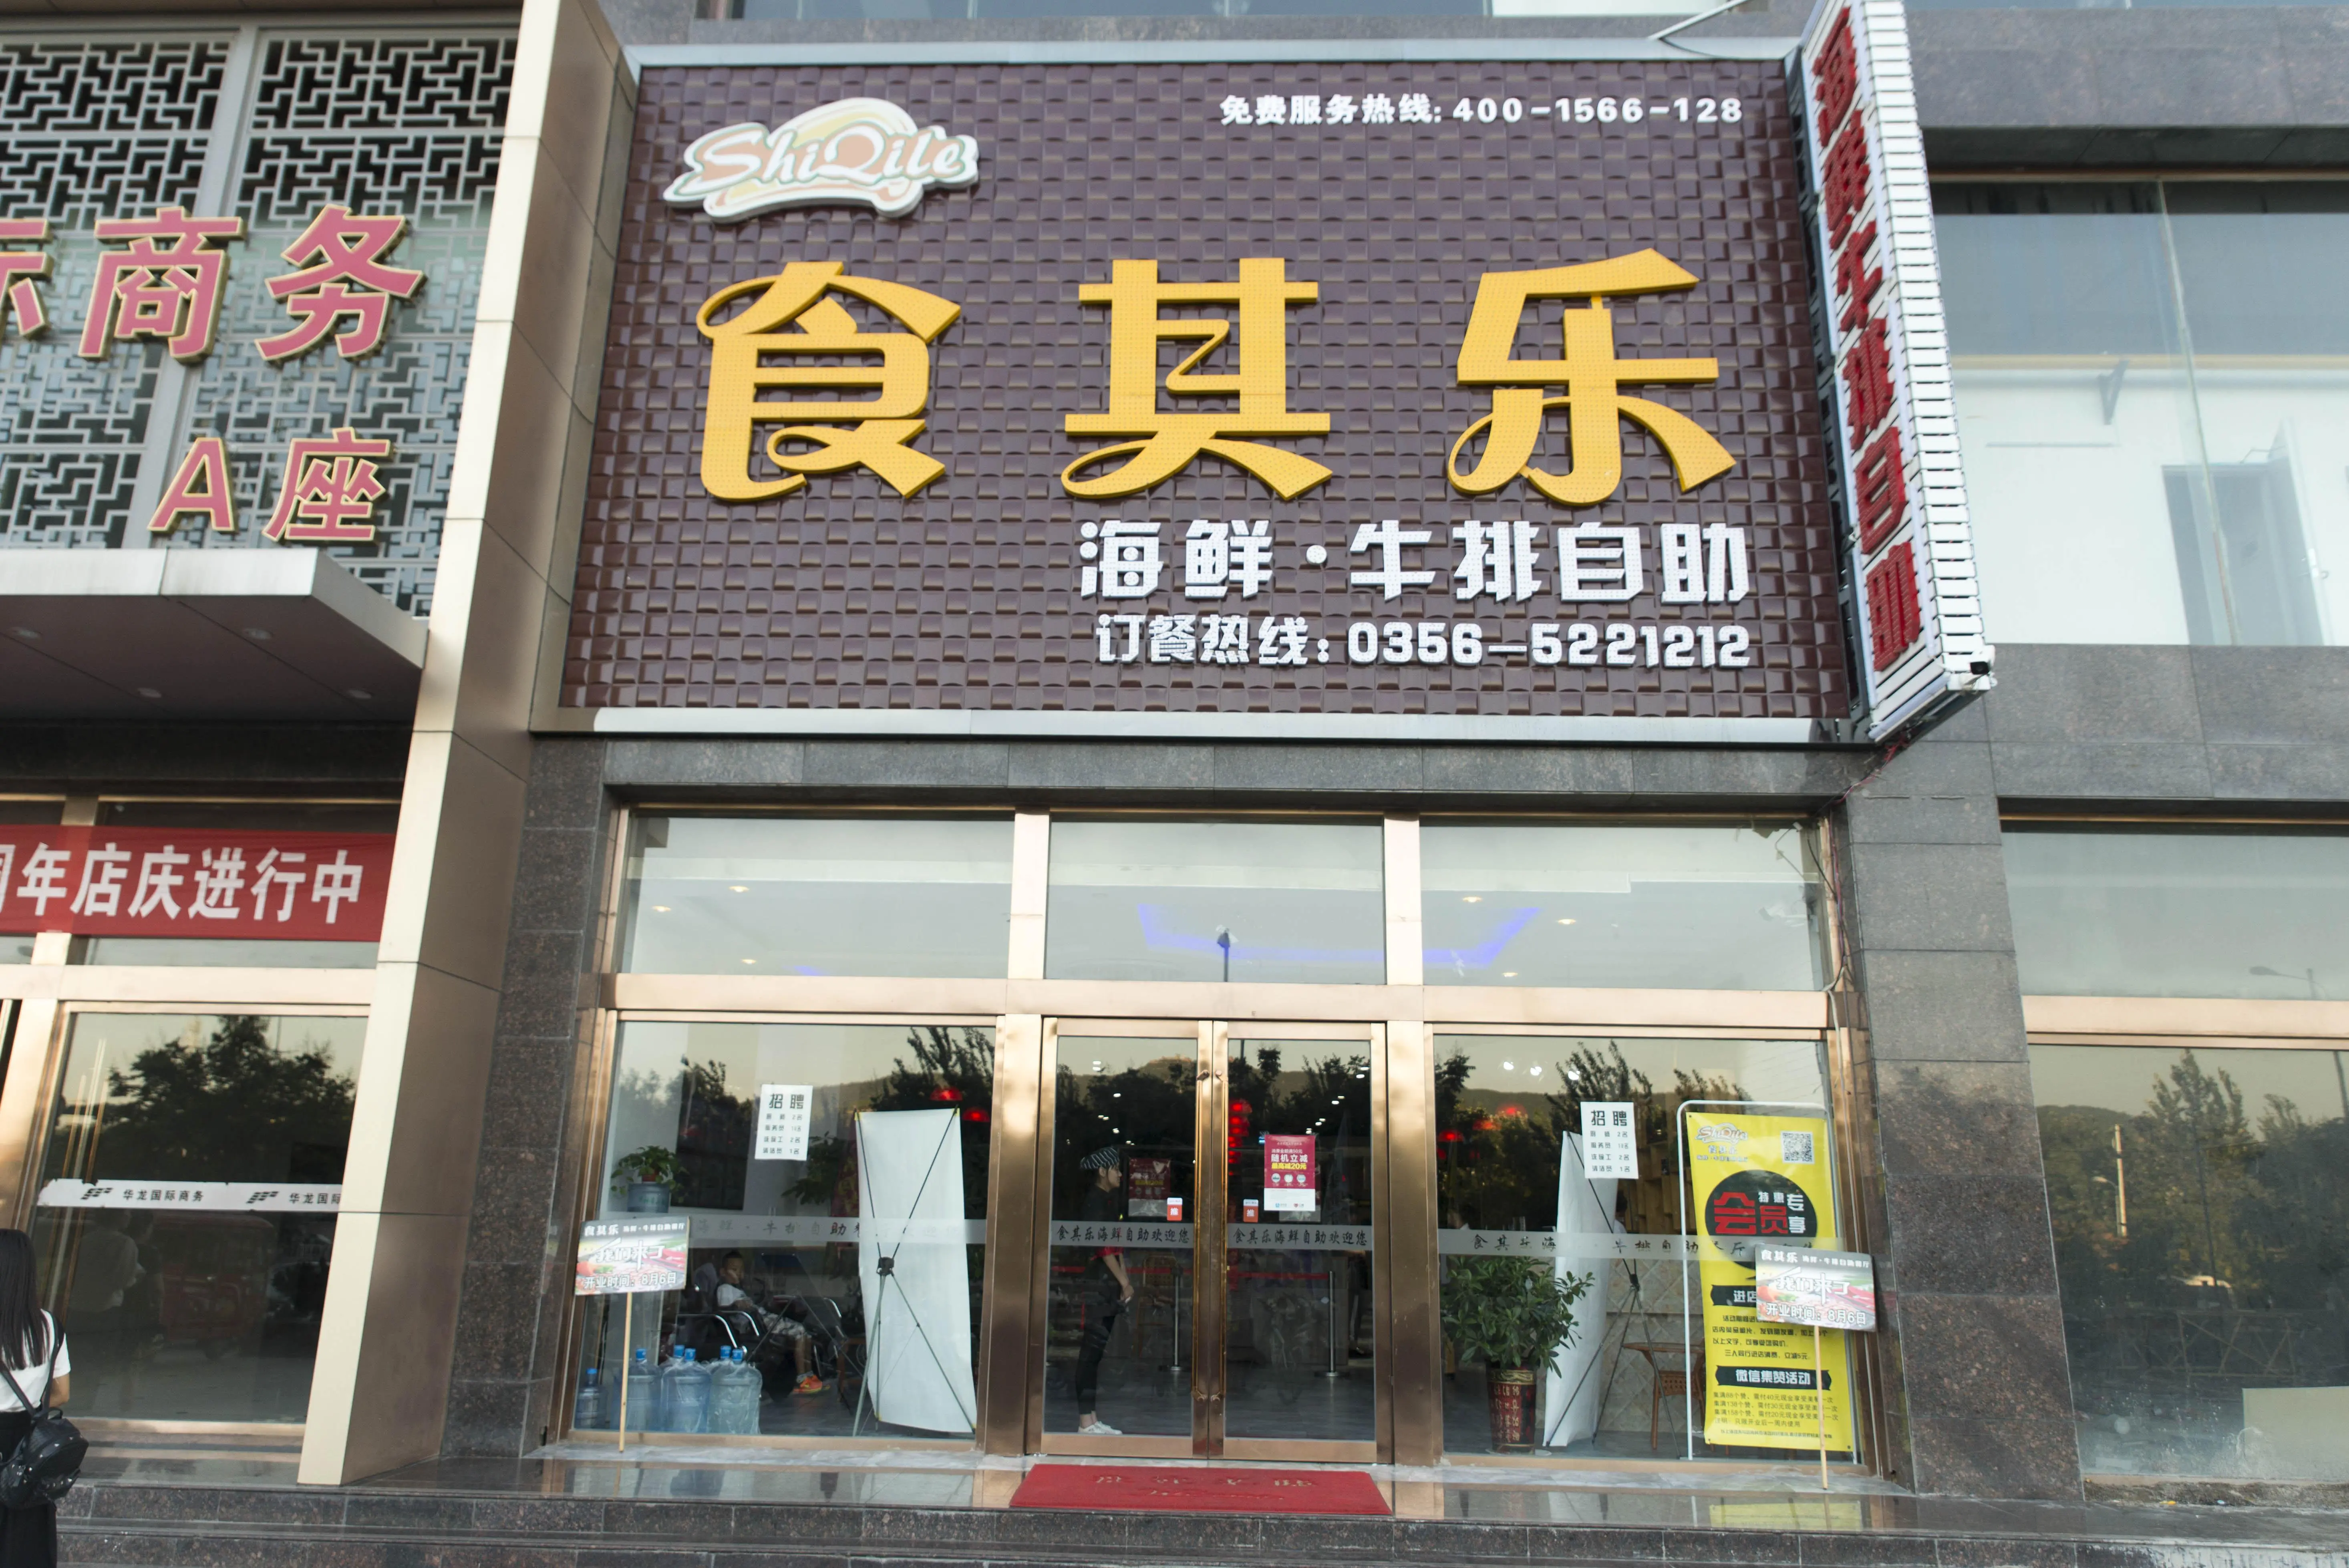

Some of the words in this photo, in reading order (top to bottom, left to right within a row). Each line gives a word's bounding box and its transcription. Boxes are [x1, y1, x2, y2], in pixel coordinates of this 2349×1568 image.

[667, 119, 976, 200] ShiQile
[1813, 5, 1921, 672] 海鲜牛排自助
[695, 247, 1737, 507] 食其乐
[769, 1093, 805, 1109] 招聘
[1590, 1109, 1627, 1126] 招聘
[1271, 1154, 1308, 1162] 随机立减
[123, 1189, 203, 1202] 华龙国际商务
[1057, 1224, 1190, 1244] 食其乐海鲜自助欢迎您
[1233, 1227, 1367, 1246] 食其乐海鲜自助欢迎您
[588, 1238, 665, 1270] 我们来了
[1769, 1266, 1851, 1304] 我们来了
[1735, 1369, 1811, 1385] 微信集赞活动
